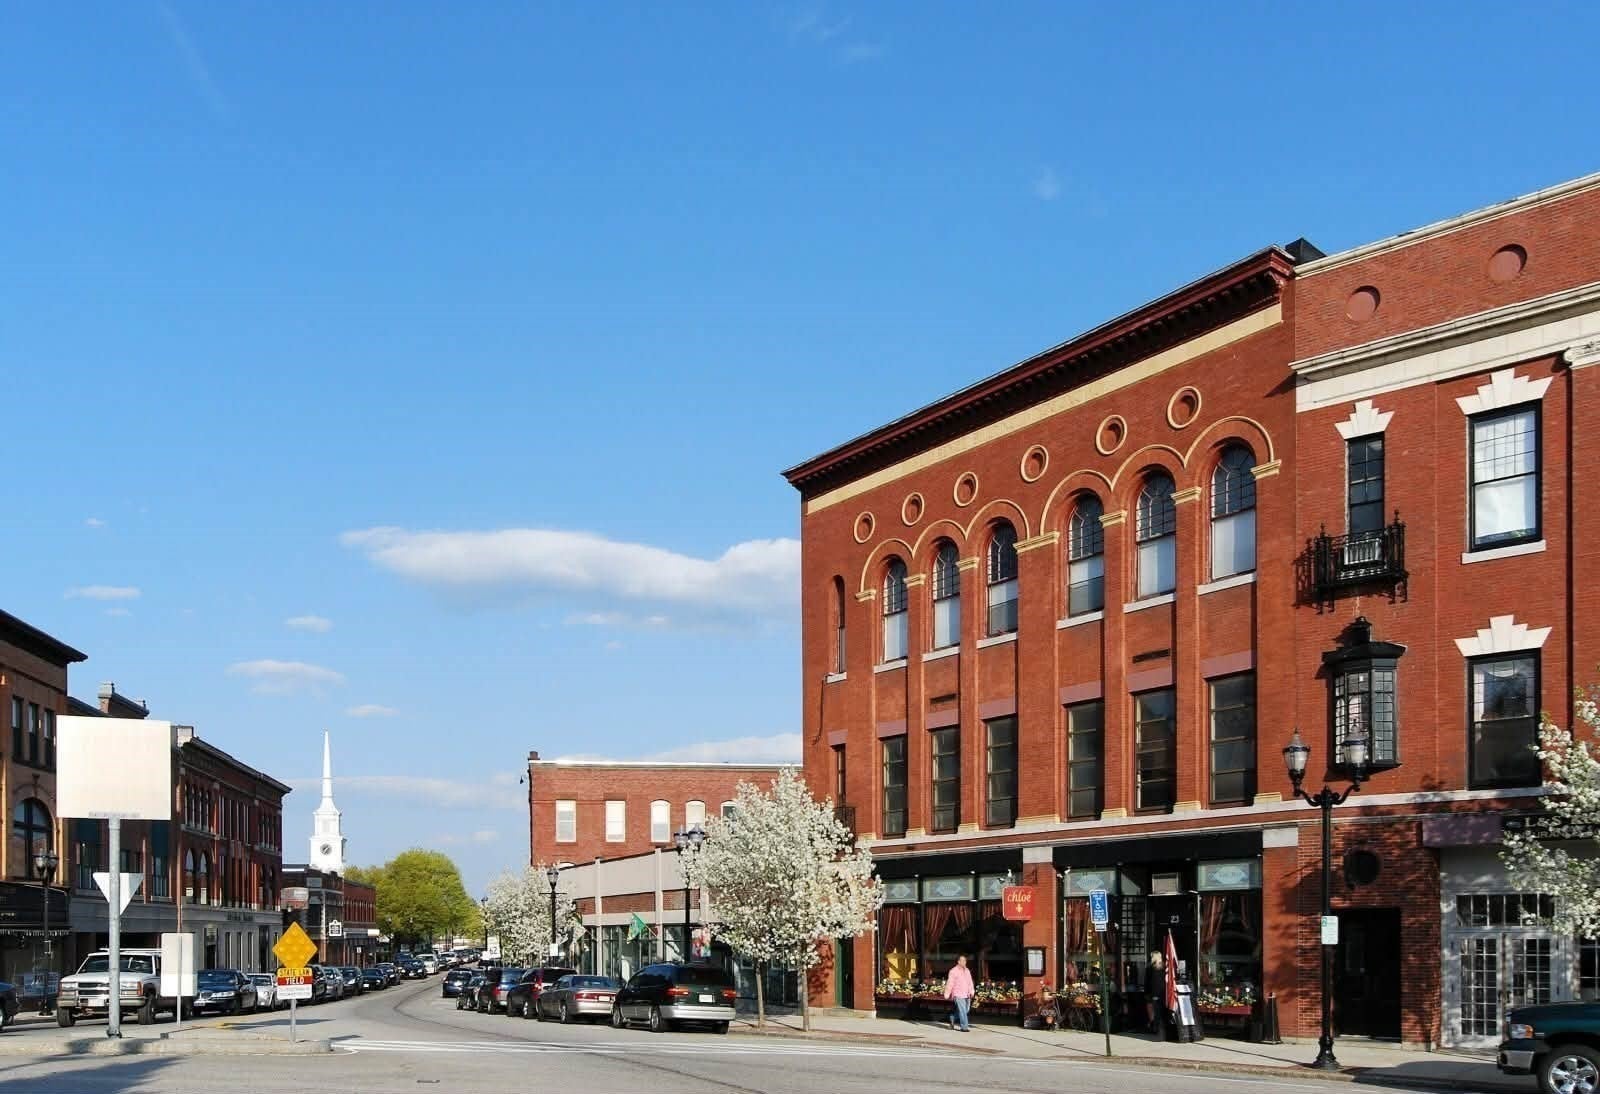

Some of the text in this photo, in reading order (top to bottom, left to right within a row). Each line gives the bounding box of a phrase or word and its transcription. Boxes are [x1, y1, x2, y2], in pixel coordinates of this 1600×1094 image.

[279, 969, 311, 977] STATE LAW
[285, 976, 305, 985] YIELD
